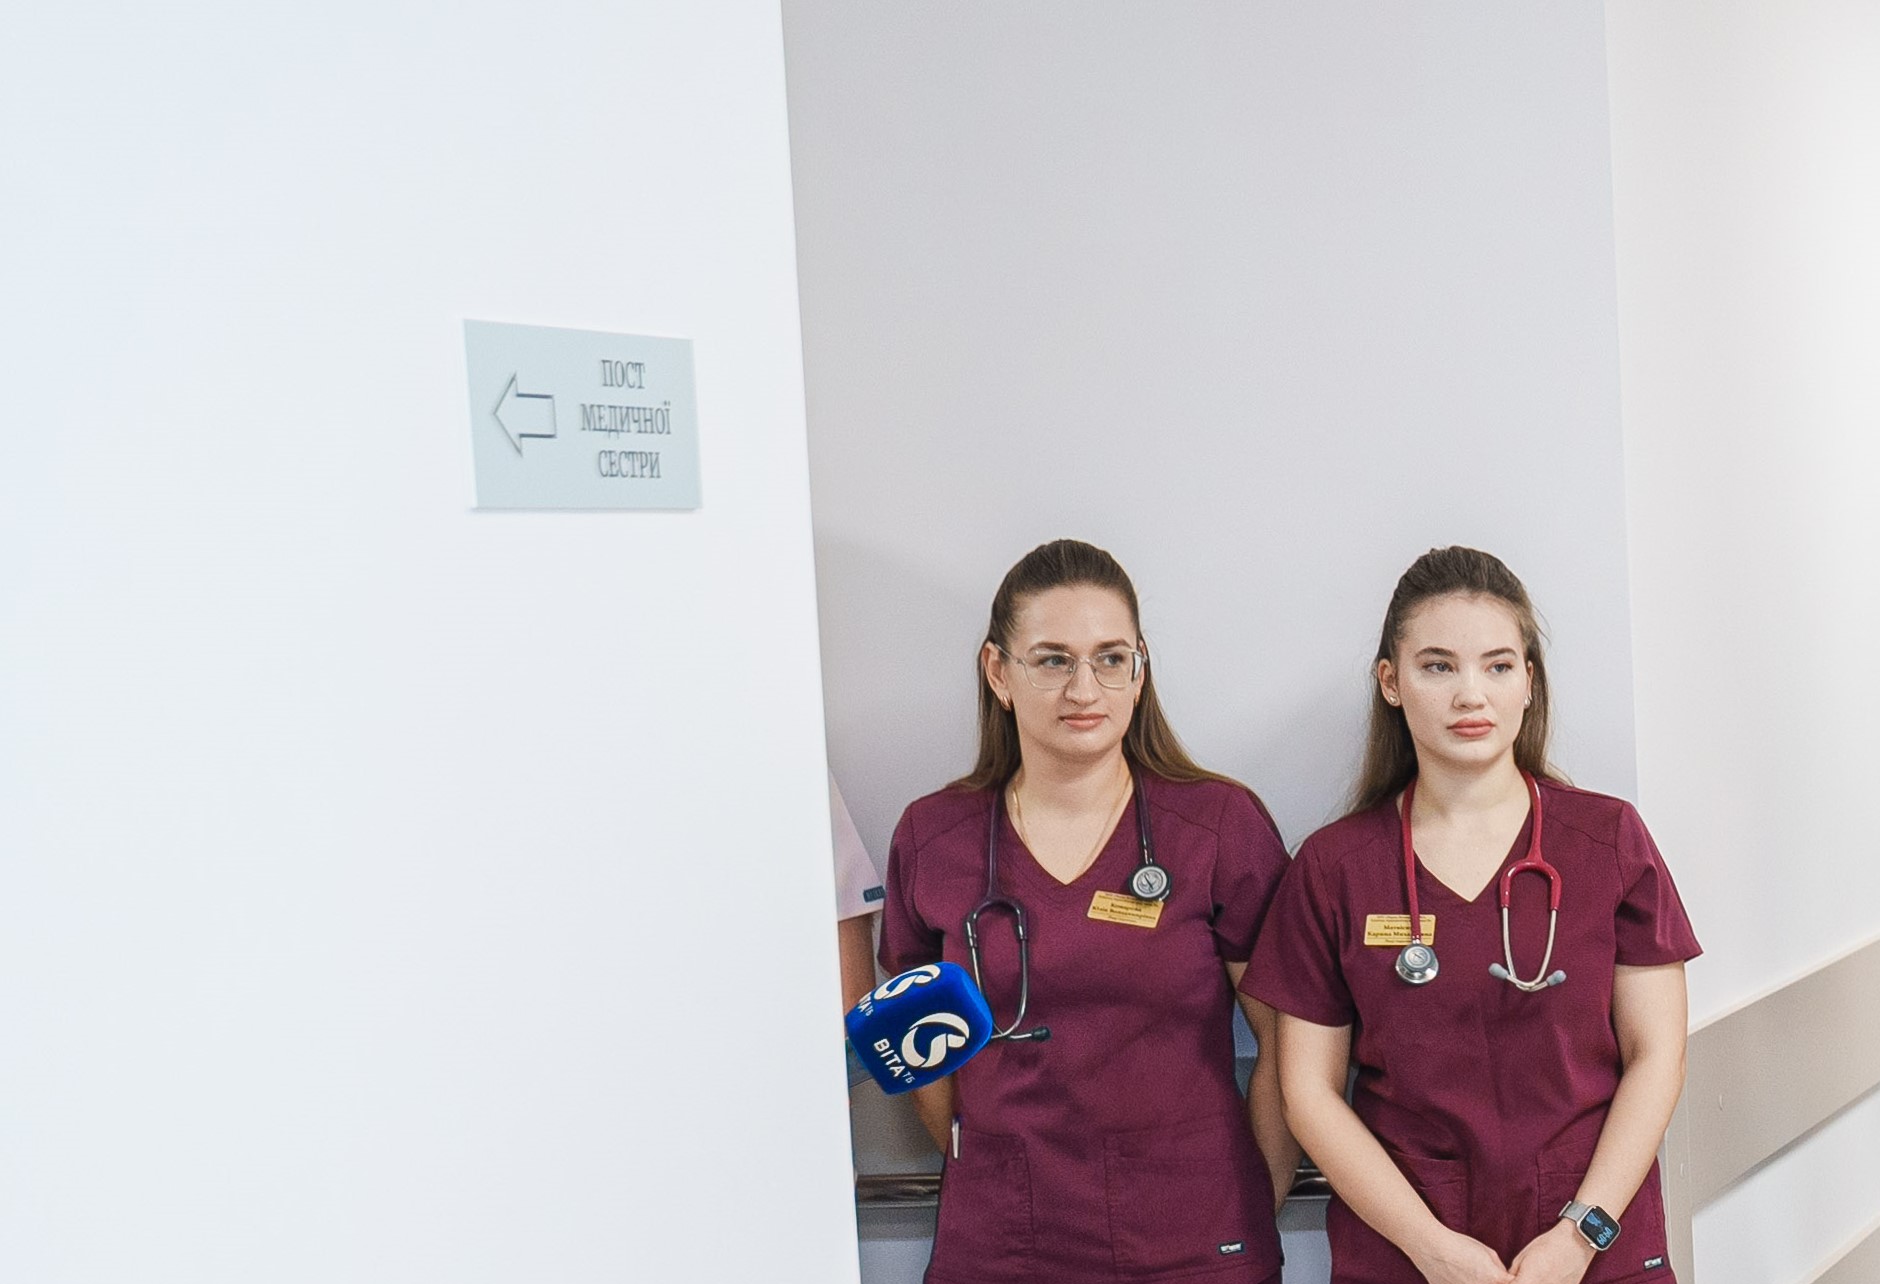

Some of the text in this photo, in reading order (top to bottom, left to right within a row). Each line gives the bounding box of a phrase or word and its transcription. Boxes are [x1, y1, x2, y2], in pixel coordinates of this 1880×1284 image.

[601, 359, 646, 389] ПОСТ
[580, 400, 672, 439] МЕДИЧНОЇ
[598, 450, 661, 479] СЕСТРИ
